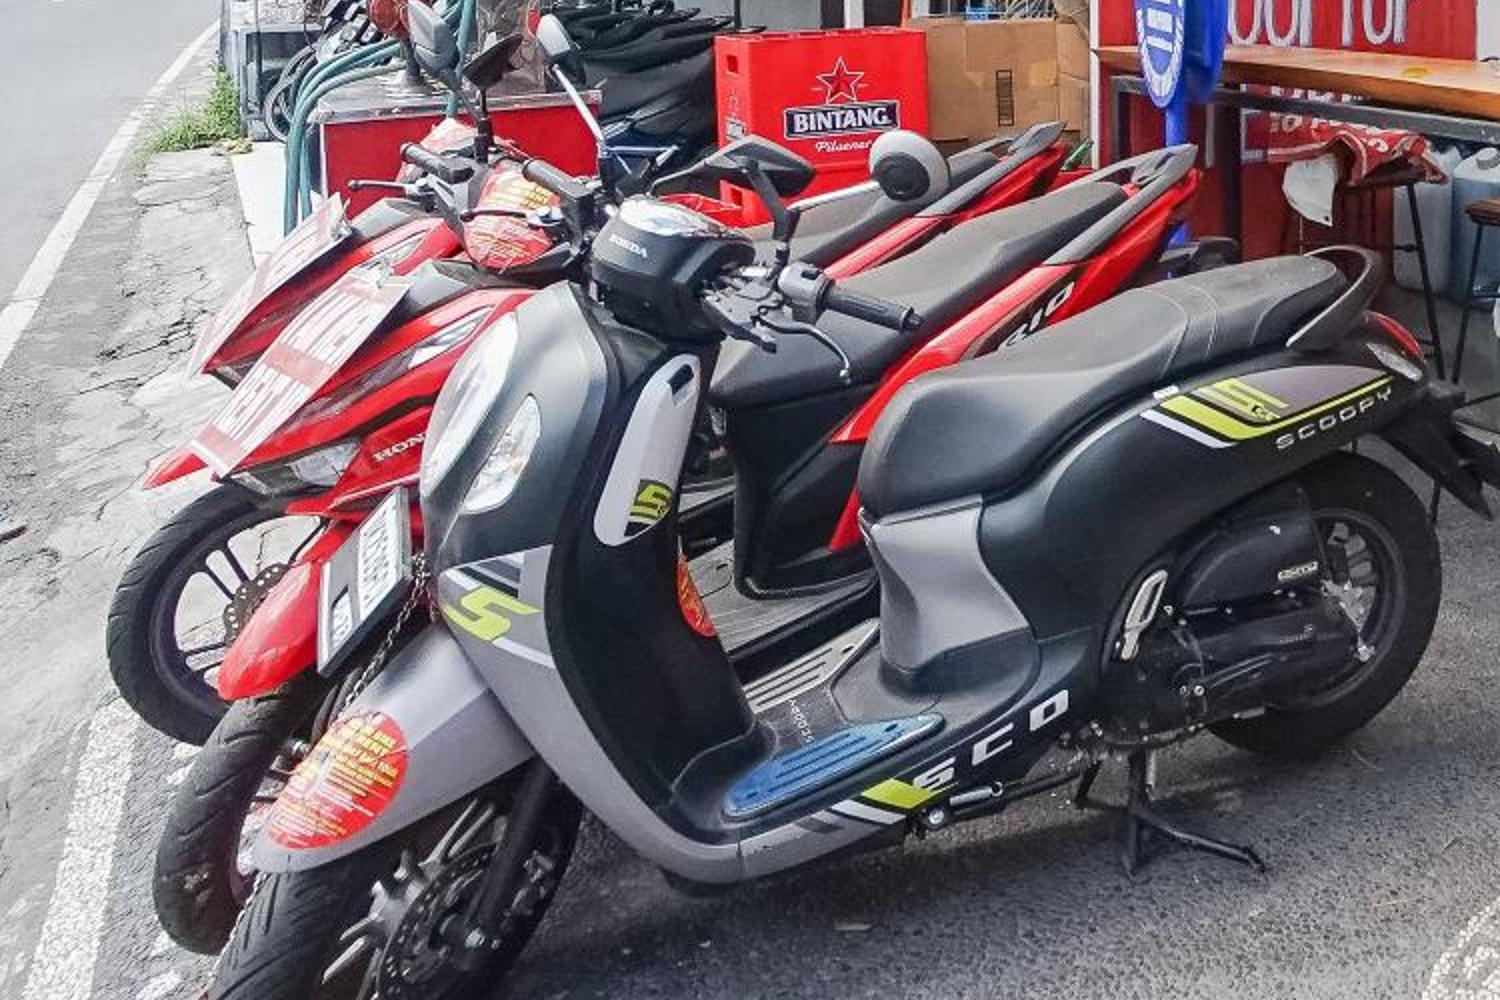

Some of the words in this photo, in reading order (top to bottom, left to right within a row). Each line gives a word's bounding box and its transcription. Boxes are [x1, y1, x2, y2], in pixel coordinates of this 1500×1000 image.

[793, 107, 891, 133] BINTANG
[1275, 386, 1392, 450] SCOOPY
[372, 432, 427, 462] HON
